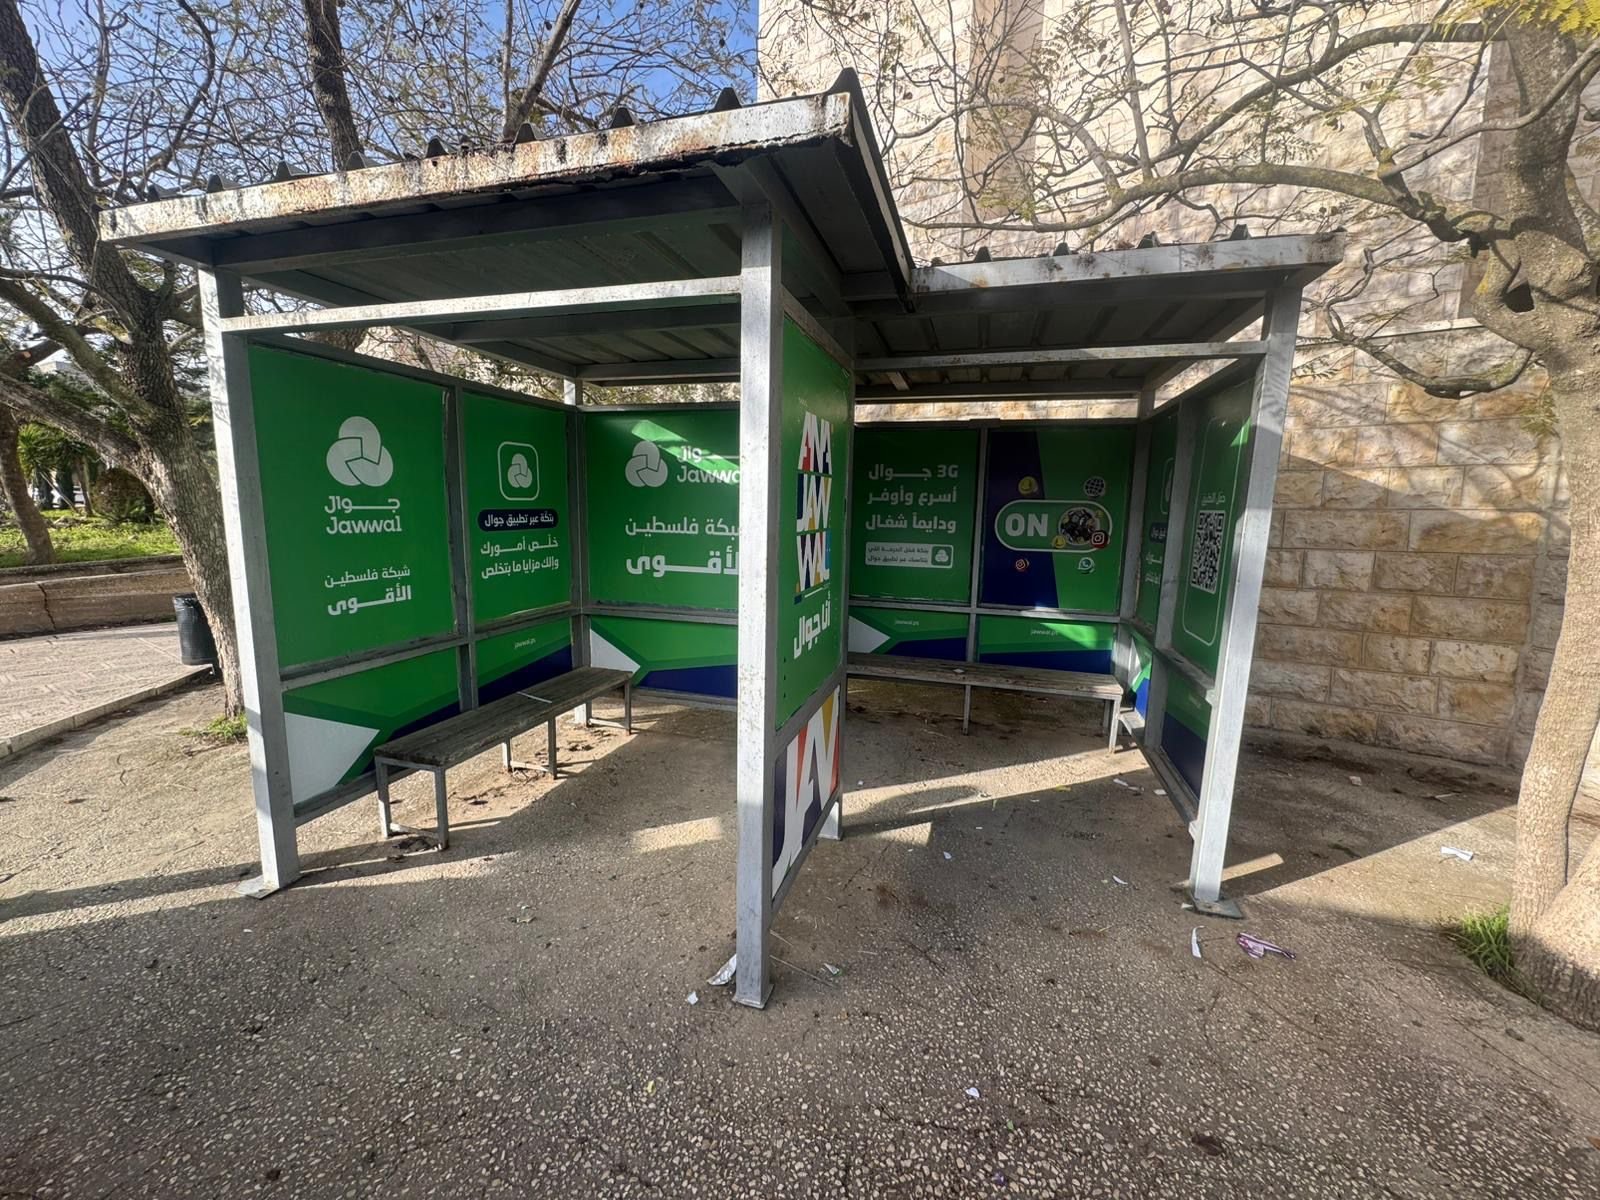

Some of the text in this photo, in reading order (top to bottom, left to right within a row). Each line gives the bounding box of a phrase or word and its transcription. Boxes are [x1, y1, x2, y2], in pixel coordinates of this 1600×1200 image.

[798, 411, 832, 476] ANA
[676, 445, 739, 464] وال
[676, 465, 739, 485] Jawwa
[868, 463, 959, 481] 3G جوال
[324, 495, 401, 514] جوال
[866, 484, 957, 506] أسرع وأوفر
[325, 515, 403, 535] Jawwal
[484, 514, 505, 528] جوال
[505, 513, 529, 528] تطبيق
[625, 515, 739, 541] بكة فلسطين
[1004, 512, 1049, 537] ON
[480, 536, 526, 557] أمورك
[481, 562, 511, 579] بتخلص
[512, 560, 522, 572] ما
[522, 559, 541, 573] مزايا
[626, 545, 739, 578] لأقوى
[796, 531, 830, 592] WAL
[324, 564, 411, 588] شبكة فلسطين
[327, 583, 412, 616] الأقوى
[793, 591, 831, 660] أنا جوال
